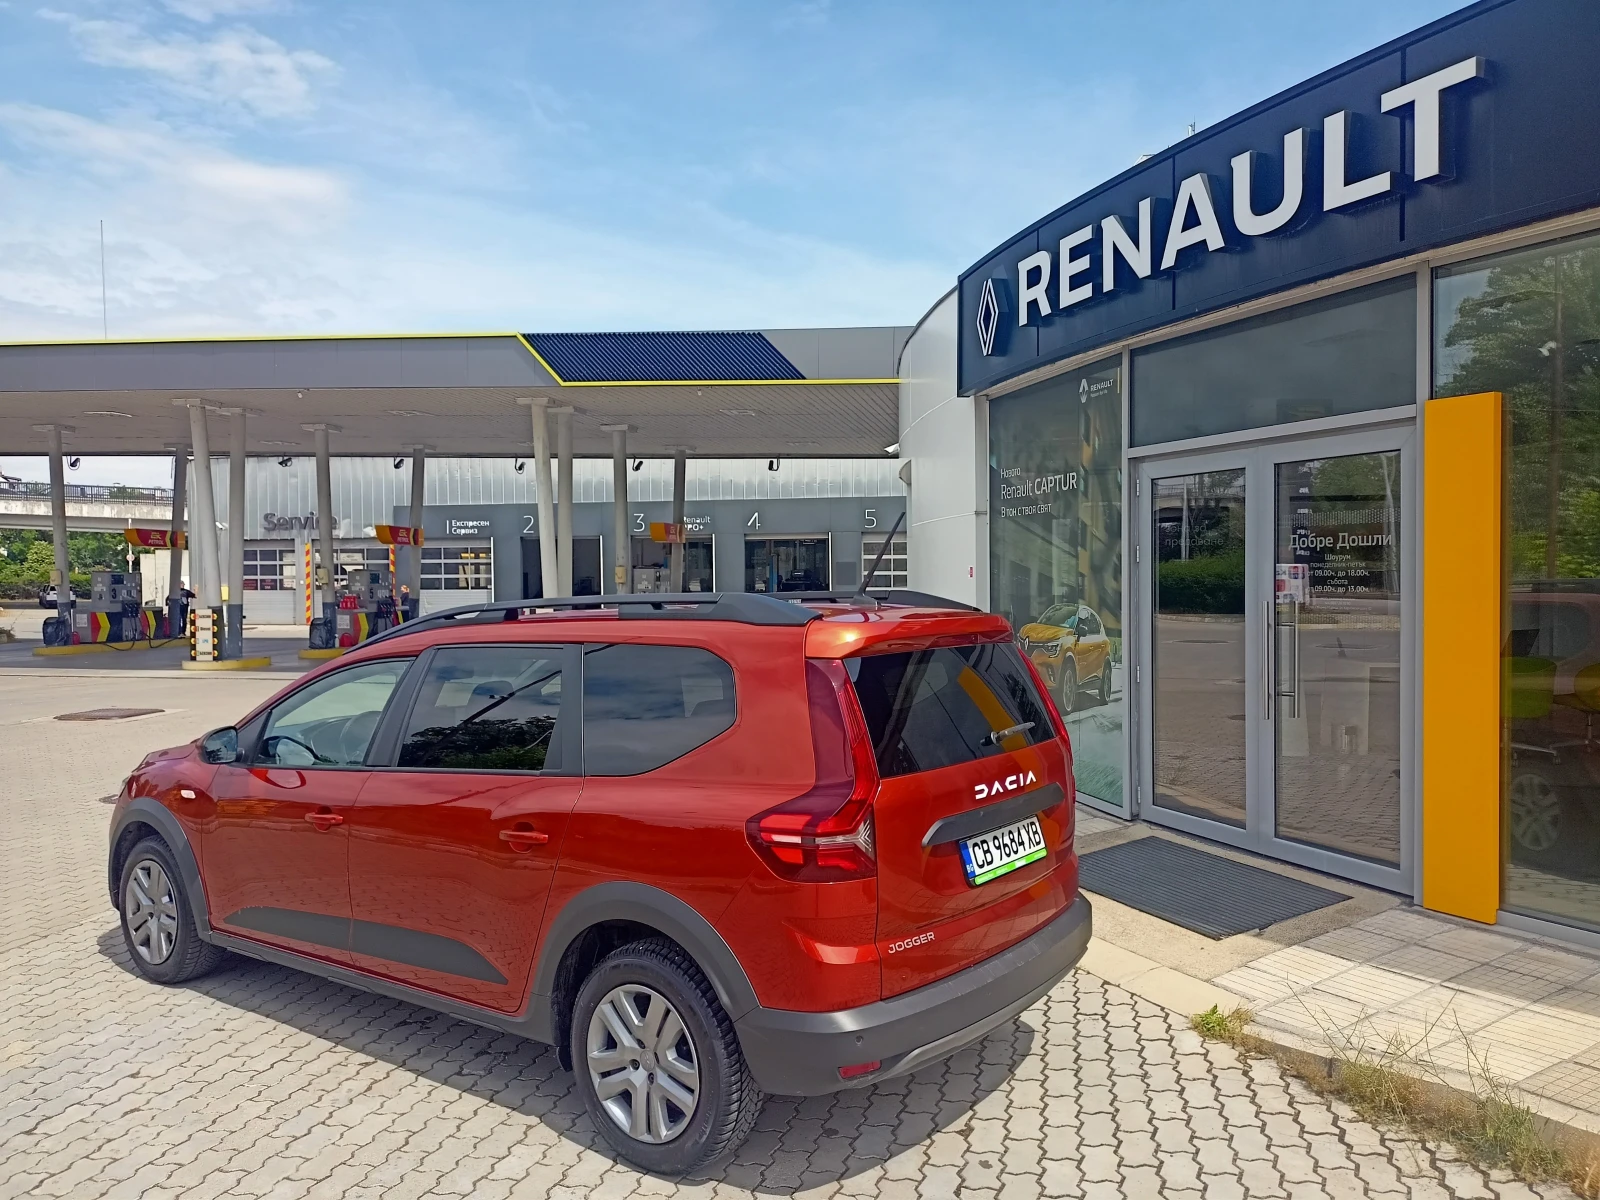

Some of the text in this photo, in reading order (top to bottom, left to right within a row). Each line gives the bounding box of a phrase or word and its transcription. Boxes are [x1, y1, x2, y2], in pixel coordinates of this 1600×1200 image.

[1017, 55, 1481, 327] RENAULT
[1090, 378, 1114, 392] RENAULT
[1000, 467, 1021, 479] Новото
[1000, 472, 1077, 500] Renault CAPTUR
[747, 511, 761, 530] 4
[864, 509, 877, 528] 5
[1001, 506, 1006, 518] В
[451, 519, 490, 529] Експресен
[451, 527, 478, 536] Сервиз
[522, 515, 535, 534] 2
[633, 513, 646, 532] 3
[1289, 532, 1392, 551] Добре Дошли
[1324, 553, 1351, 562] Шоурум
[111, 588, 117, 600] 3
[369, 588, 374, 599] 5
[974, 770, 1037, 800] DACIA
[971, 820, 1042, 870] CB 9684 XB
[966, 863, 975, 874] BG
[887, 931, 936, 954] JOGGER
